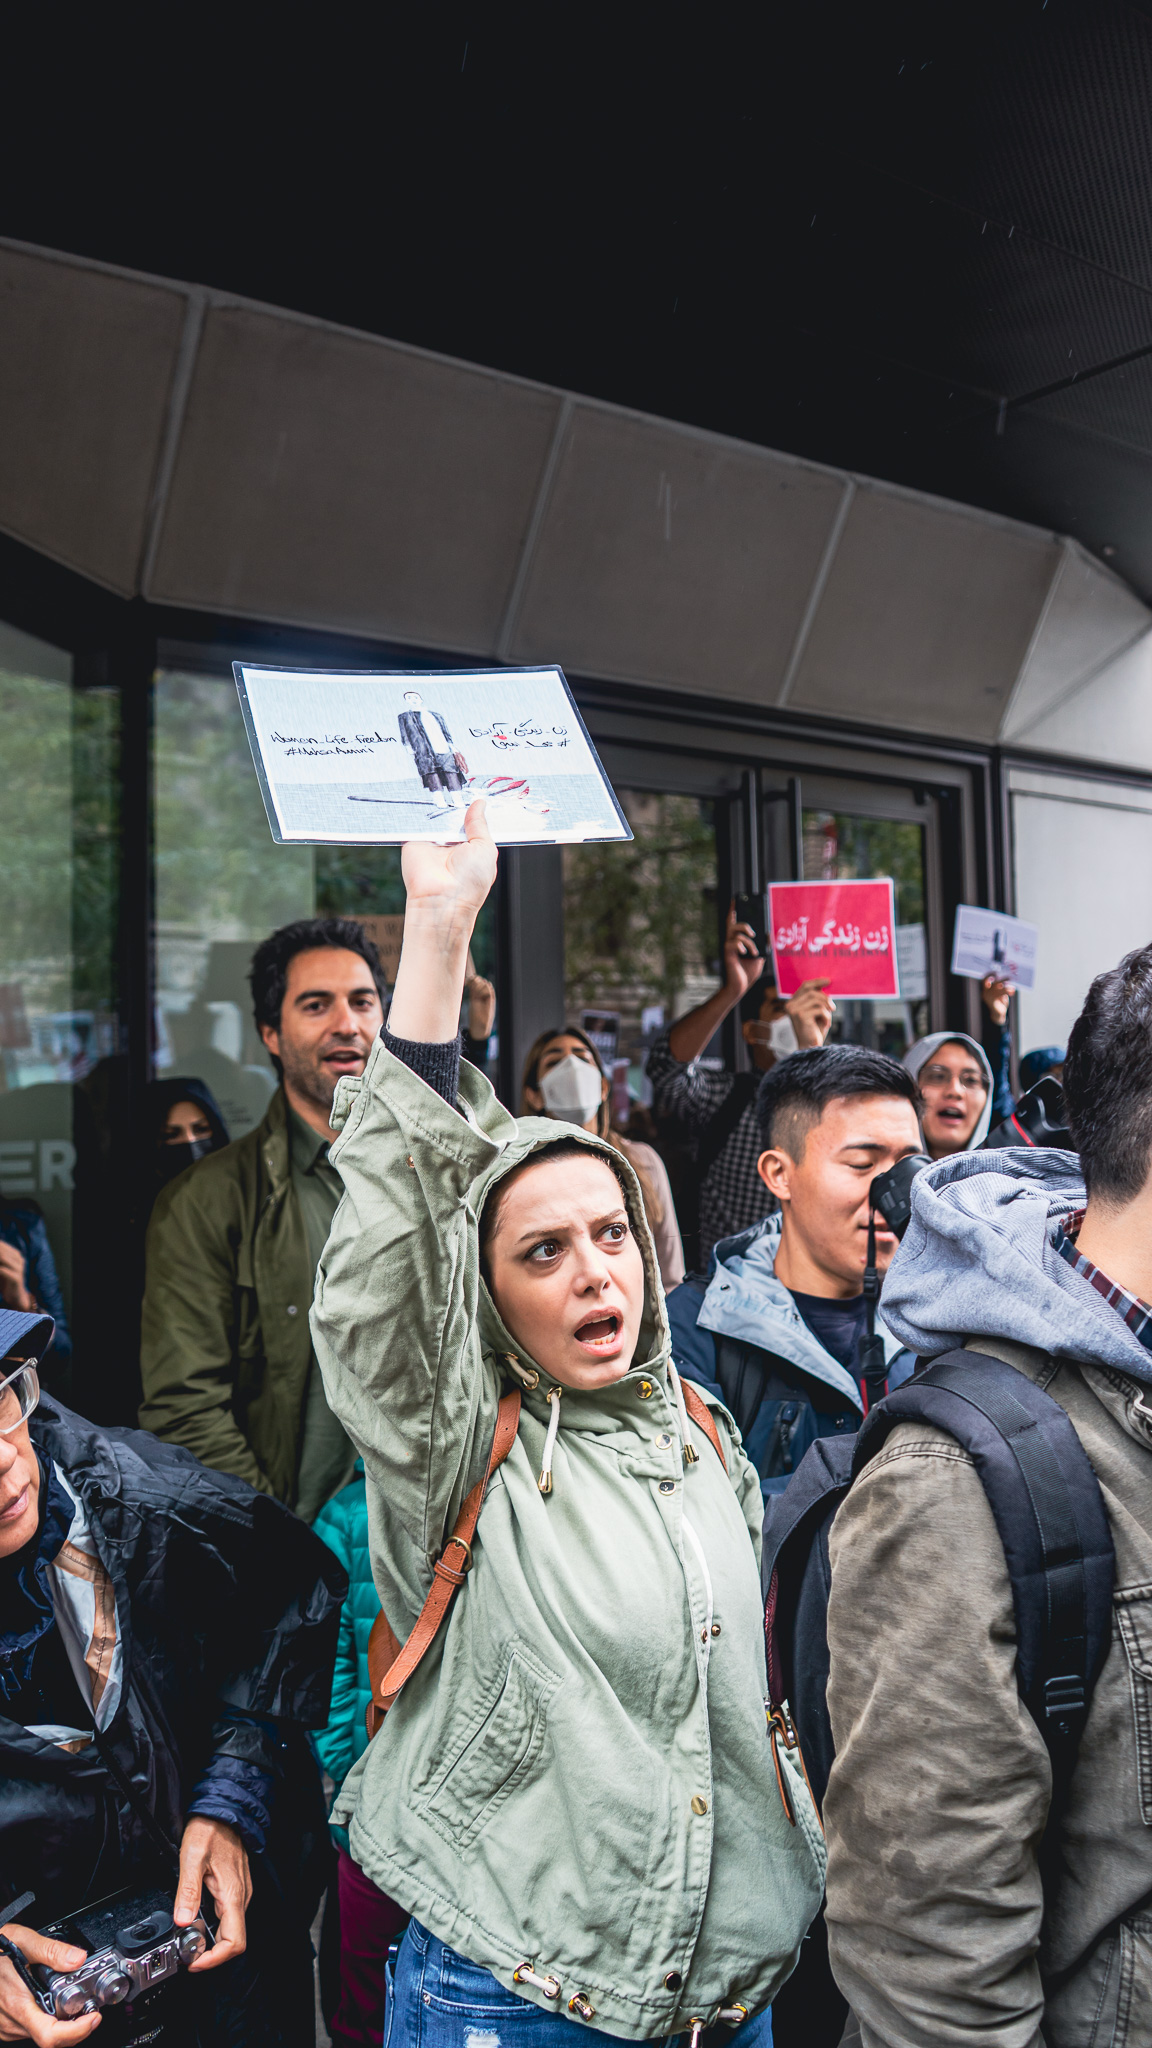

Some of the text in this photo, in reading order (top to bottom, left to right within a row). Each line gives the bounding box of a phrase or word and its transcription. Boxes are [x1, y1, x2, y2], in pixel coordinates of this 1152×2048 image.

[775, 916, 889, 952] زن زندگی آزادی
